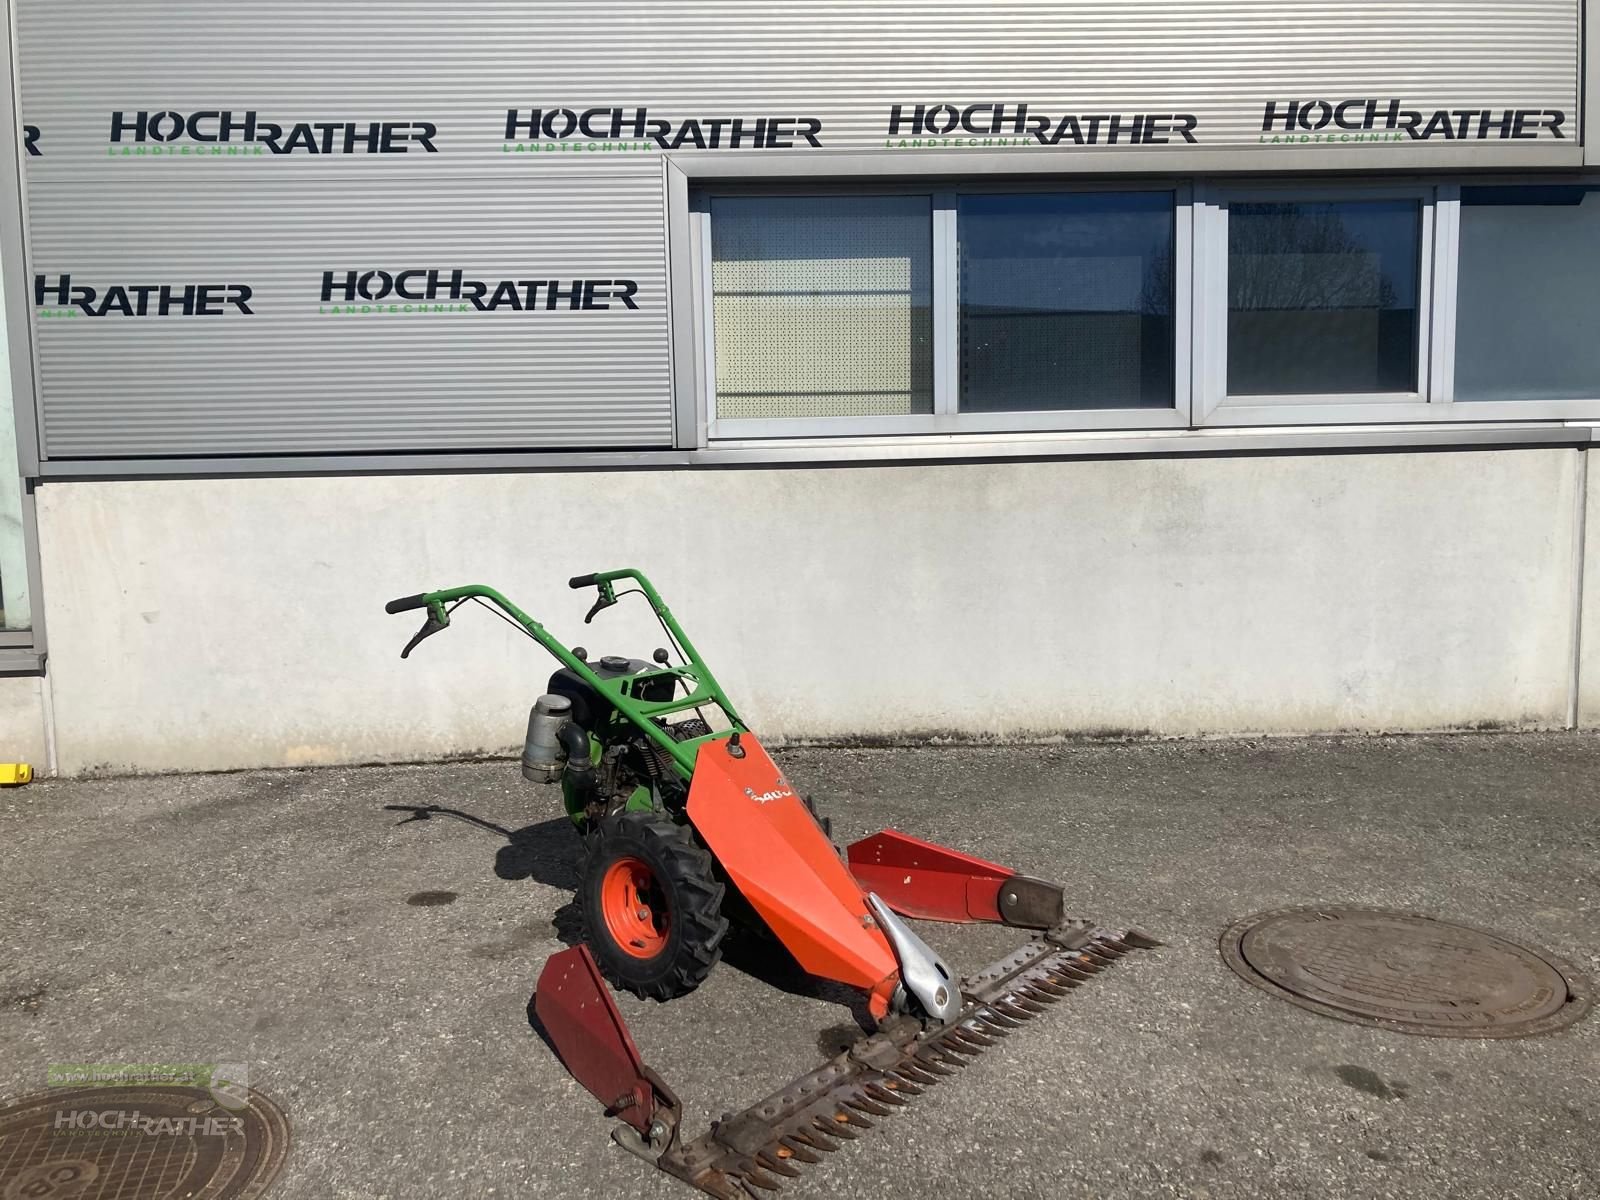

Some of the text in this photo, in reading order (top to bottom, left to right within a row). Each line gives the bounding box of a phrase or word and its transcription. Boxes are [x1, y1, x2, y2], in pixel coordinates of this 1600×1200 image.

[110, 111, 437, 155] HOCHRATHER
[505, 107, 823, 150] HOCHRATHER
[888, 103, 1199, 146] HOCHRATHER
[1258, 132, 1403, 143] LANDTECHNIK
[1262, 99, 1566, 142] HOCHRATHER
[107, 145, 263, 157] LANDTECHNIK
[502, 142, 652, 153] LANDTECHNIK
[885, 138, 1032, 148] LANDTECHNIK
[34, 274, 255, 317] HRATHER
[319, 303, 470, 315] LANDTECHNIK
[320, 269, 640, 311] HOCHRATHER
